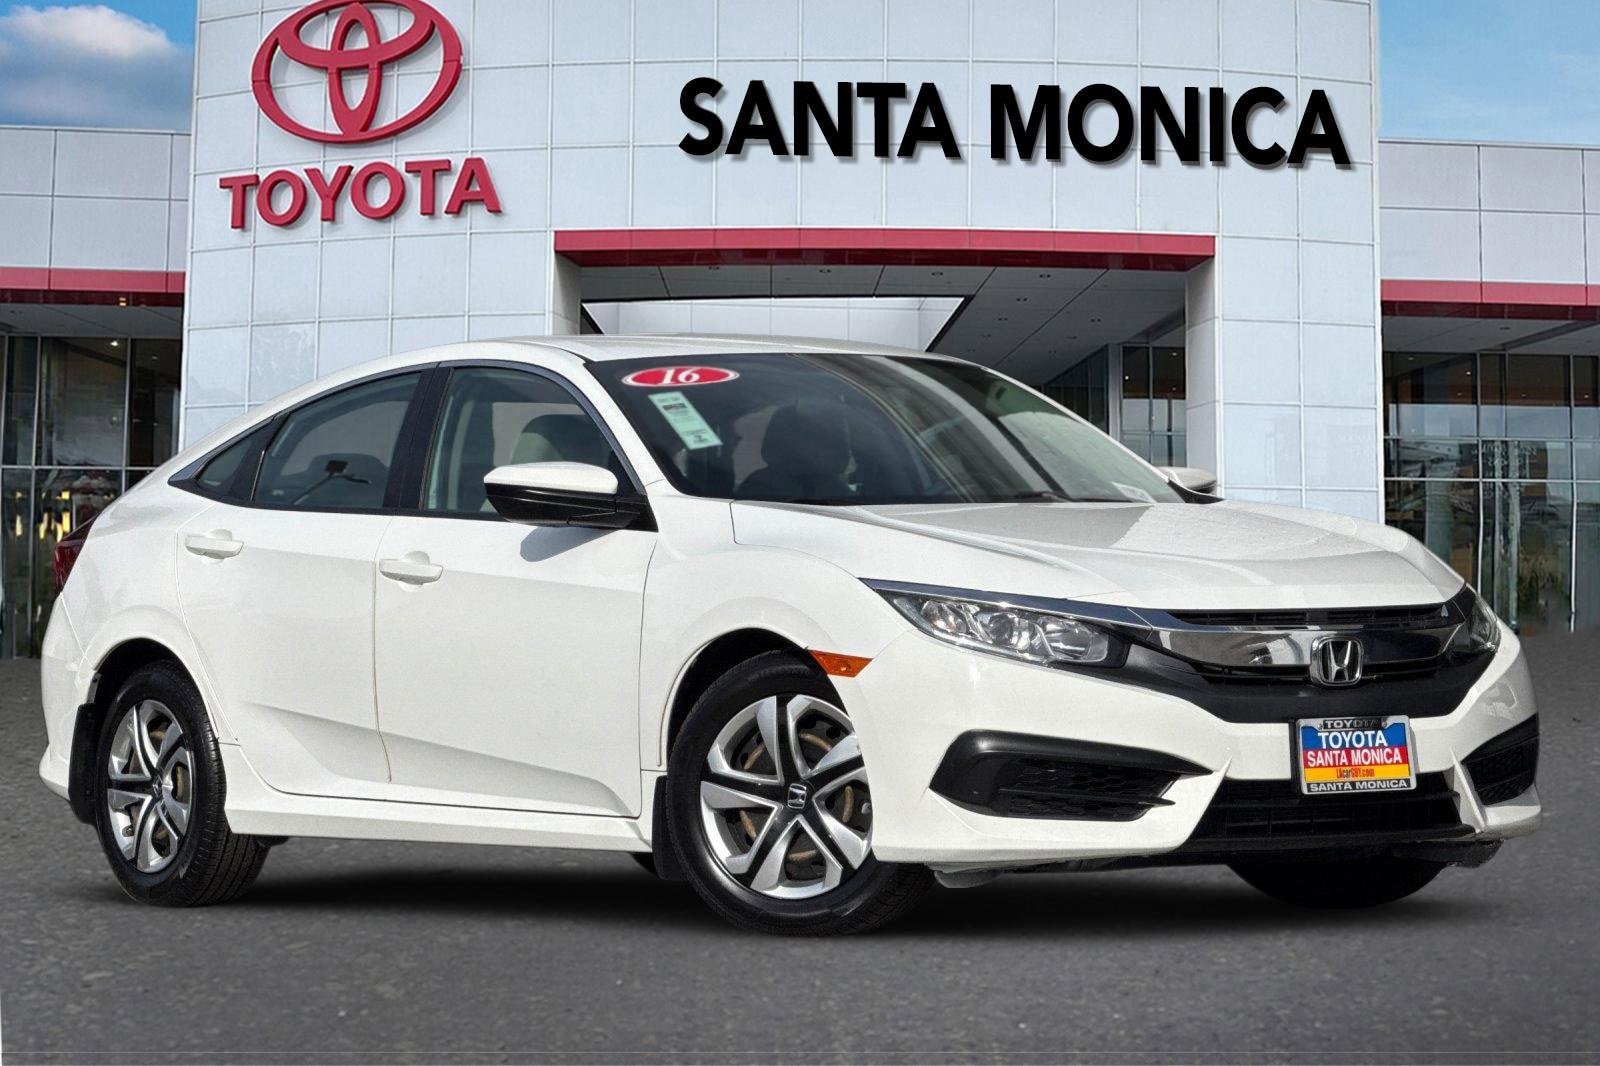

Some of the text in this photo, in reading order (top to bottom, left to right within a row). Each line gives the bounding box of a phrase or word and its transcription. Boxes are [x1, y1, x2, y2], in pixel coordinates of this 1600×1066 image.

[678, 77, 1352, 170] SANTA MONICA
[219, 156, 502, 230] TOYOTA
[661, 368, 700, 384] 16
[1325, 719, 1379, 728] TOYOTA
[1318, 730, 1388, 749] TOYOTA
[1308, 748, 1402, 767] SANTA MONICA
[1310, 780, 1407, 792] SANTA MONICA
